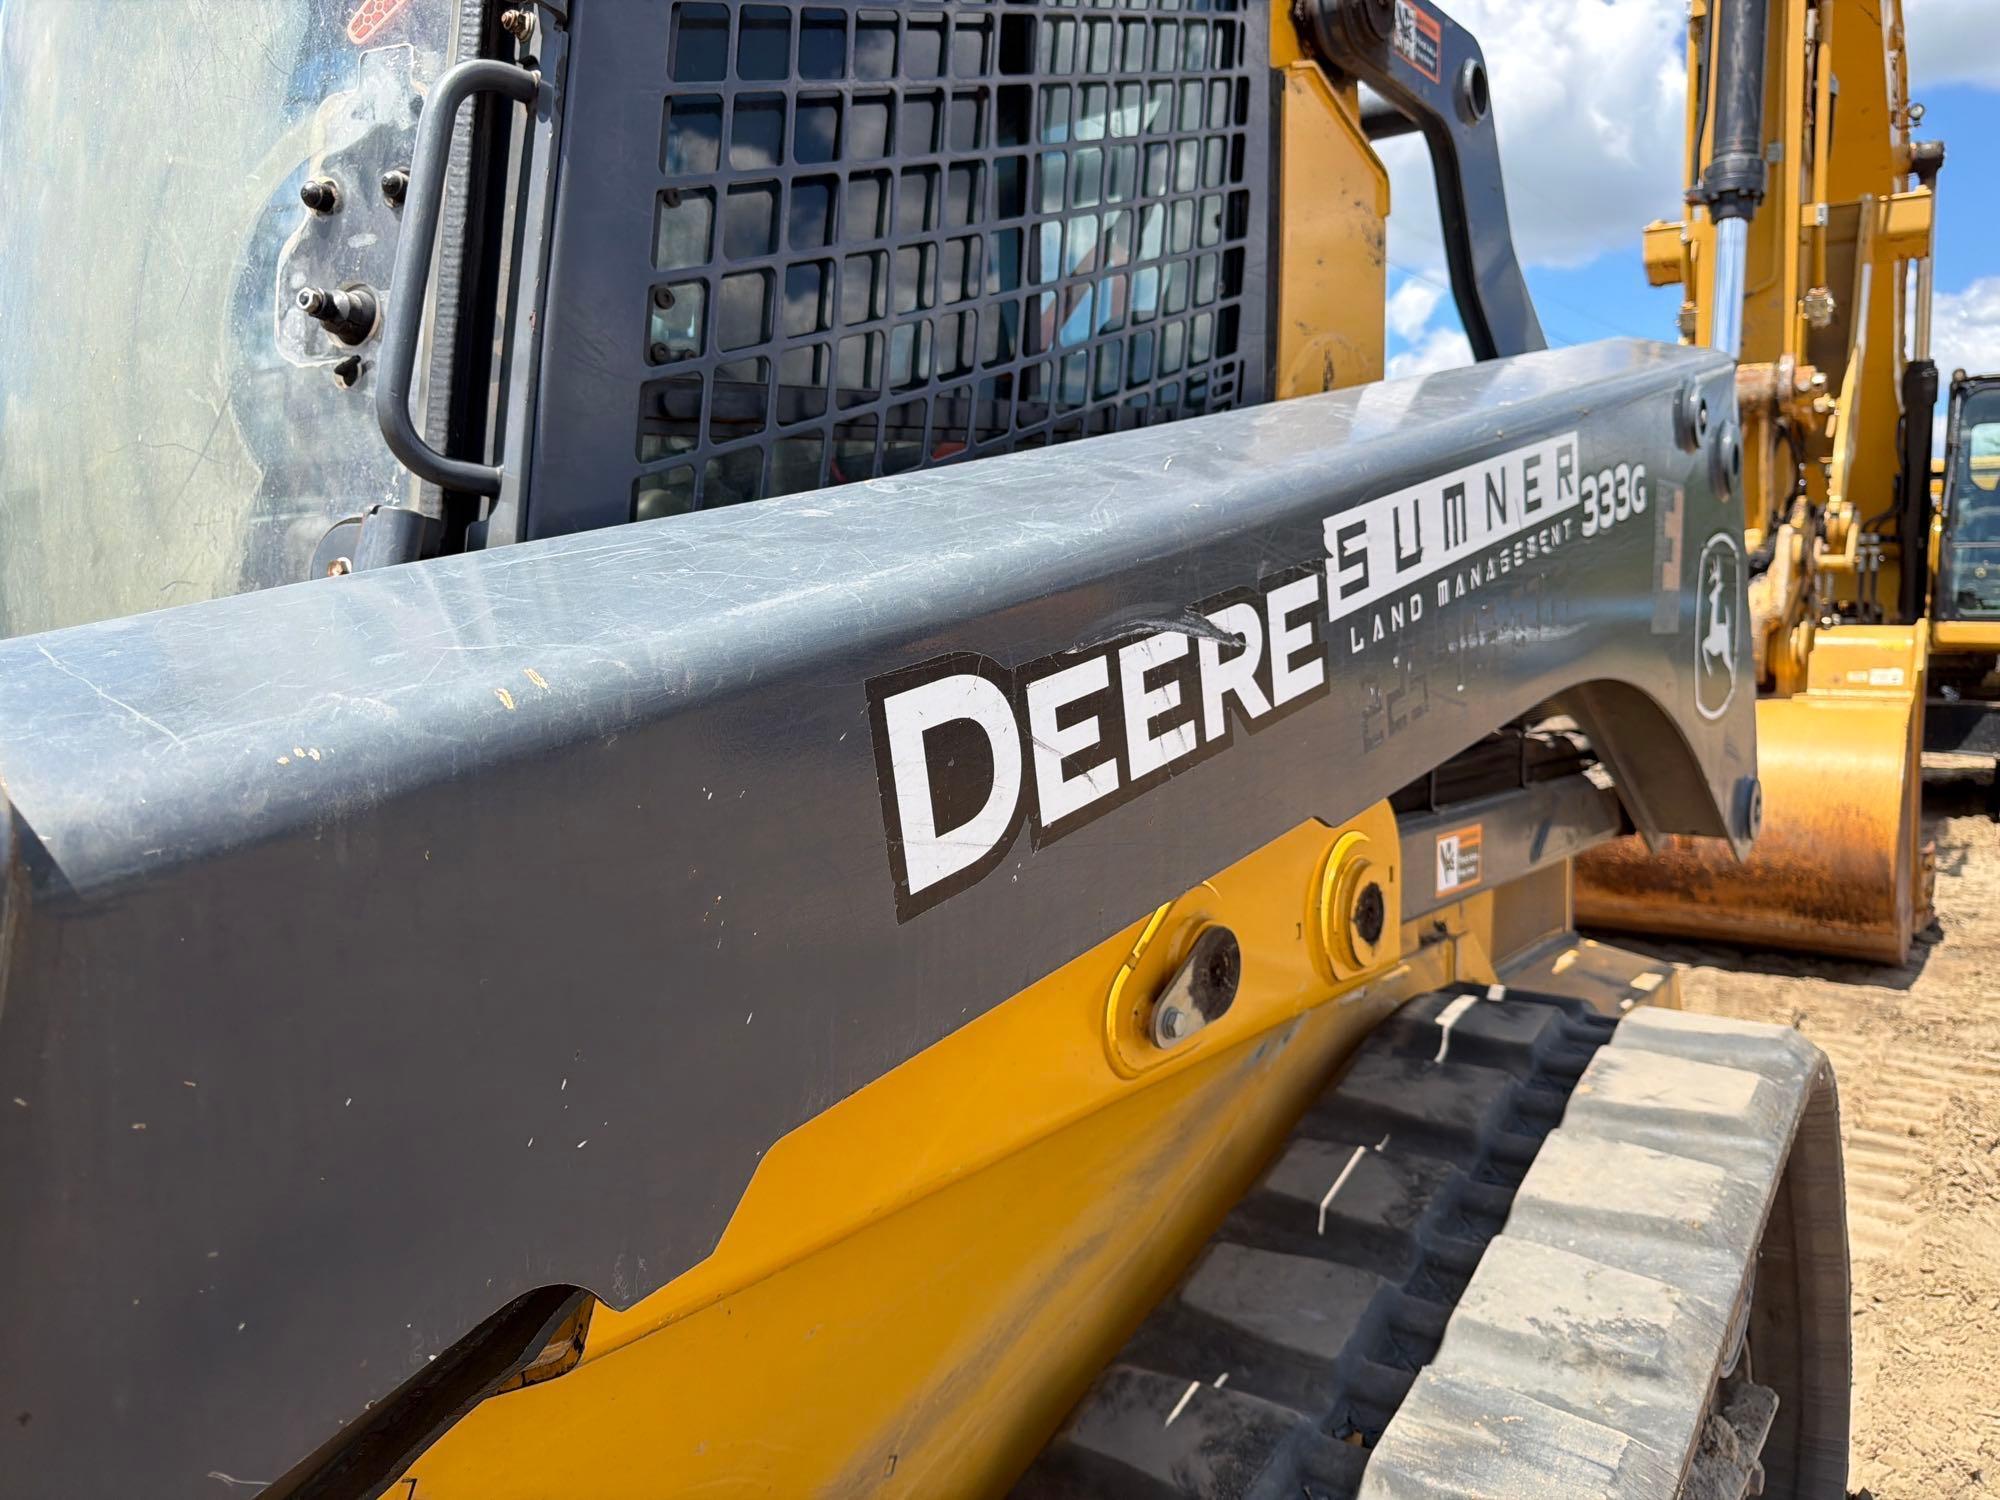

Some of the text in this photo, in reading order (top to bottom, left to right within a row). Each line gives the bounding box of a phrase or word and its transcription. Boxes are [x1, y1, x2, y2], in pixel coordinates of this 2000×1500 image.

[1336, 443, 1573, 600] SUMNER
[1581, 463, 1647, 538] 333G
[1350, 593, 1422, 654] LAND
[1437, 518, 1573, 607] MANAGEMENT
[884, 574, 1325, 896] DEERE
